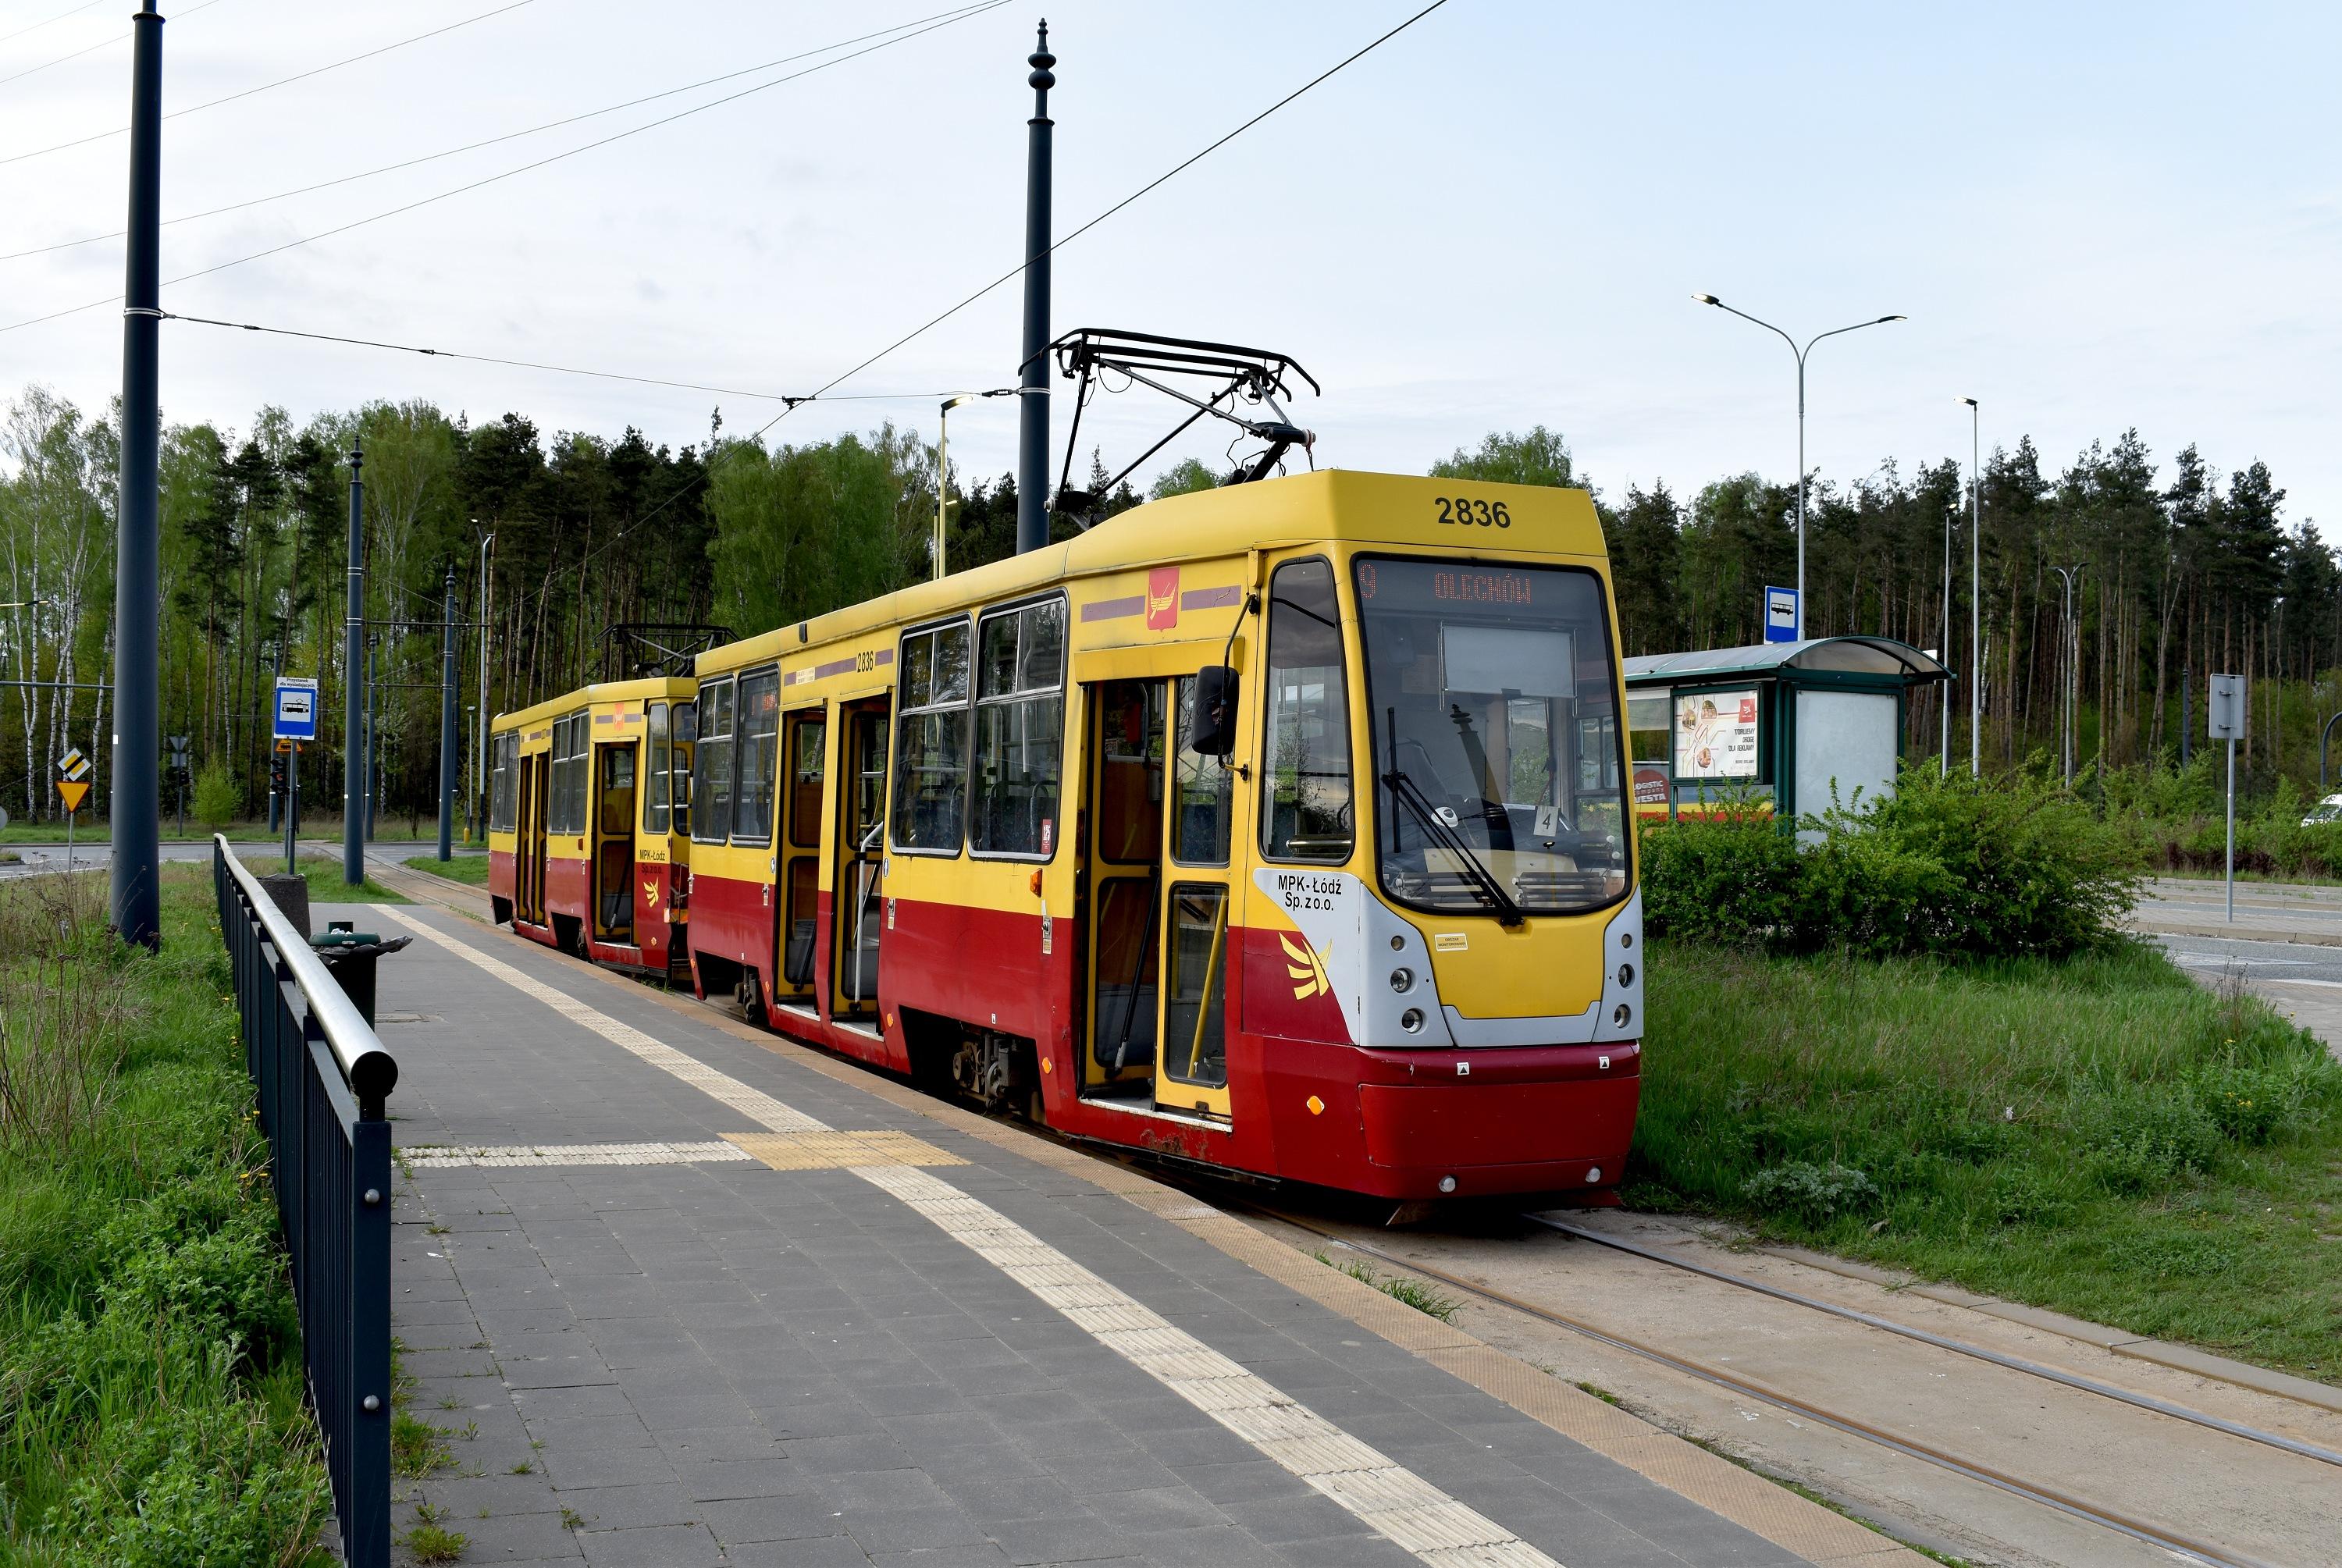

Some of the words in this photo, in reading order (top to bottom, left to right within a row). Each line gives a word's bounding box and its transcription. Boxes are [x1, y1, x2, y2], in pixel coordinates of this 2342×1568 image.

[1435, 497, 1511, 528] 2836
[1360, 564, 1376, 599] 9
[1435, 572, 1531, 604] OLECHÓW
[857, 650, 874, 673] 2836
[1542, 812, 1551, 830] 4
[639, 849, 666, 861] MPK-Łódź
[1284, 891, 1303, 912] Sp.
[1304, 897, 1312, 908] z
[1313, 898, 1333, 911] o.o.
